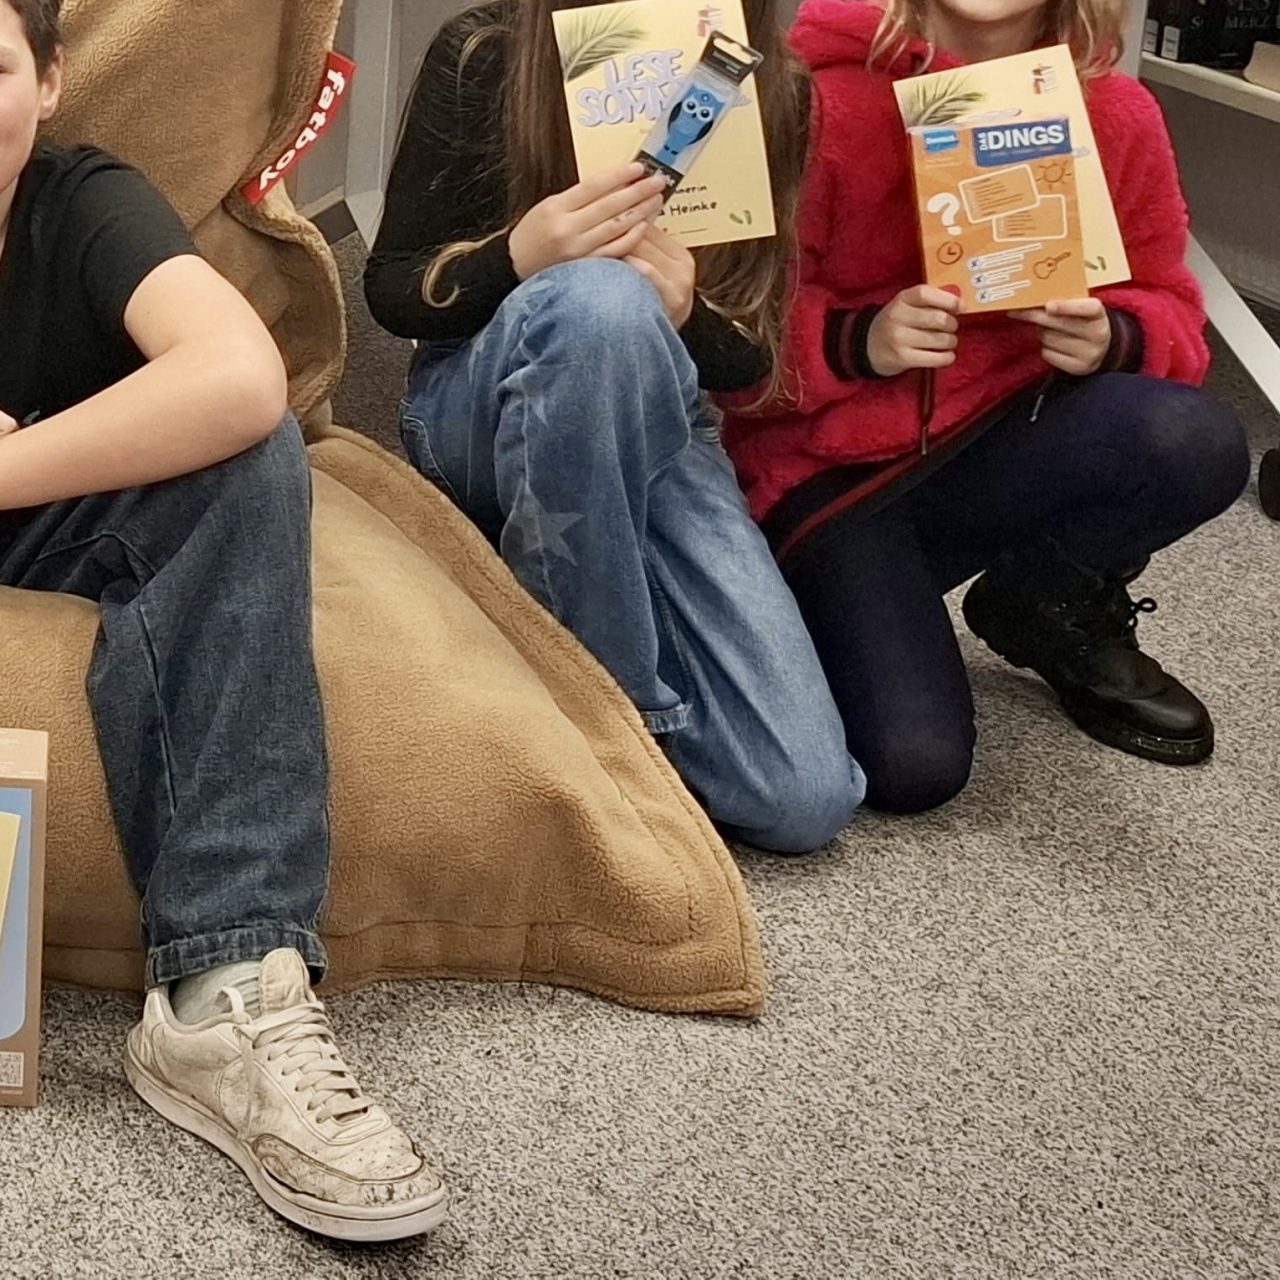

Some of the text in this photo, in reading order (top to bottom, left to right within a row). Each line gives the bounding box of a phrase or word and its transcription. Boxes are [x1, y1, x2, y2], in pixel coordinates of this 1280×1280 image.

[604, 48, 685, 93] LESE
[258, 69, 346, 192] fatboy
[987, 124, 1065, 150] DINGS
[670, 200, 718, 217] Heinke
